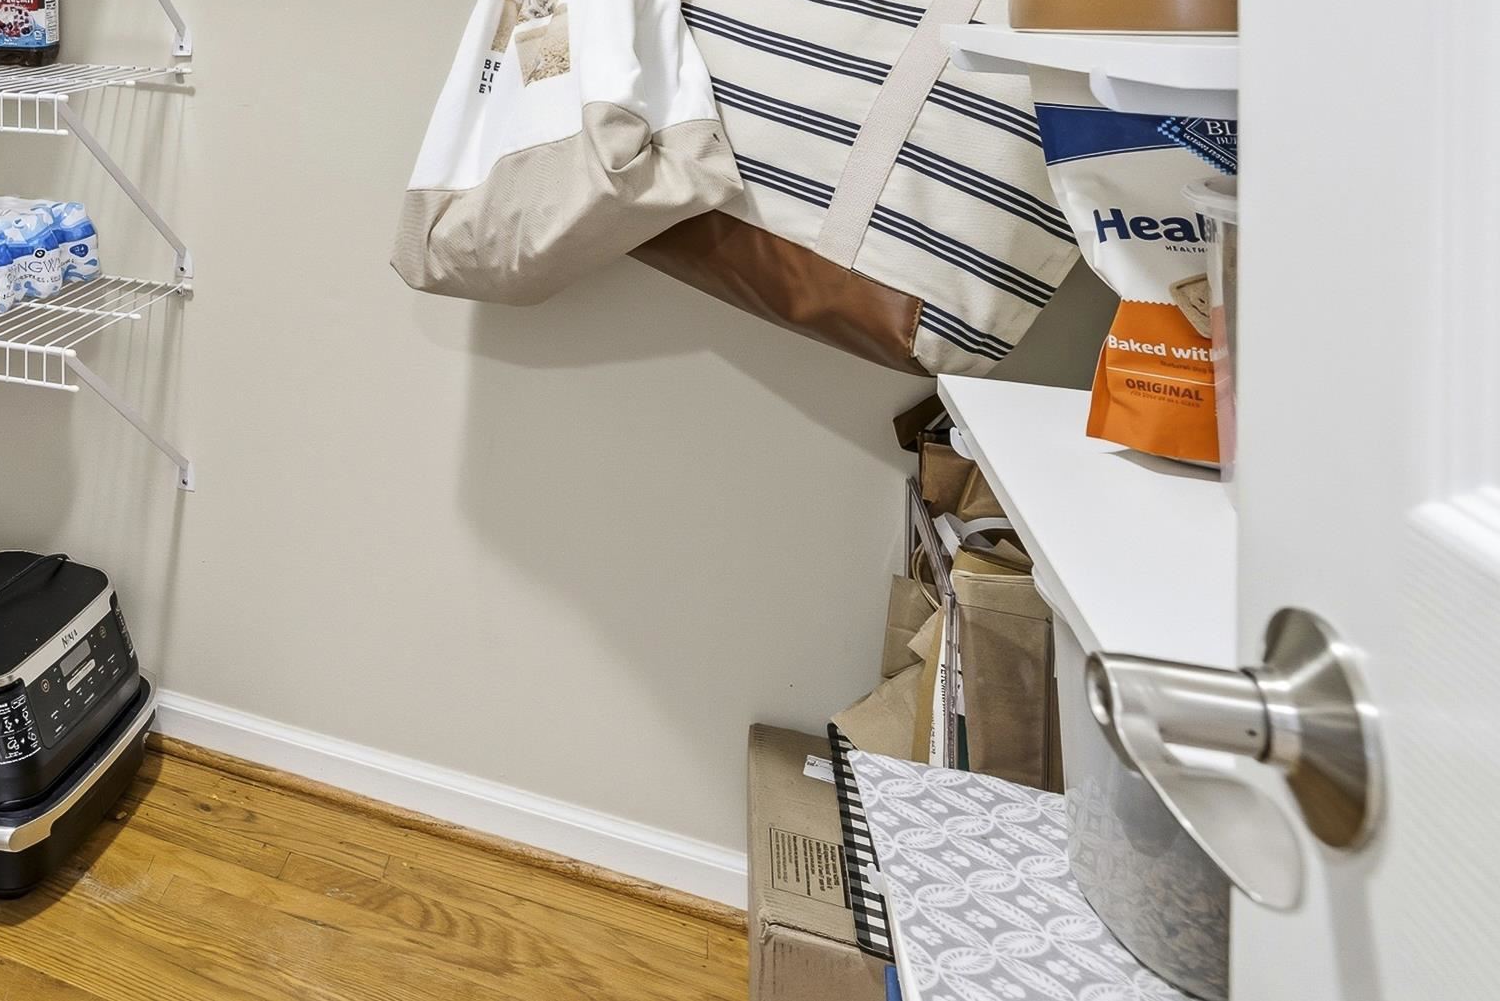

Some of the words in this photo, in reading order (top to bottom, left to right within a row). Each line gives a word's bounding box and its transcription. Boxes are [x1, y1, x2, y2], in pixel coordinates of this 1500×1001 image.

[483, 58, 501, 72] BE
[481, 70, 494, 83] LI
[1206, 120, 1238, 136] BL
[1165, 245, 1206, 254] HEALTH
[1107, 334, 1167, 357] Baked
[1125, 378, 1204, 402] ORIGINAL
